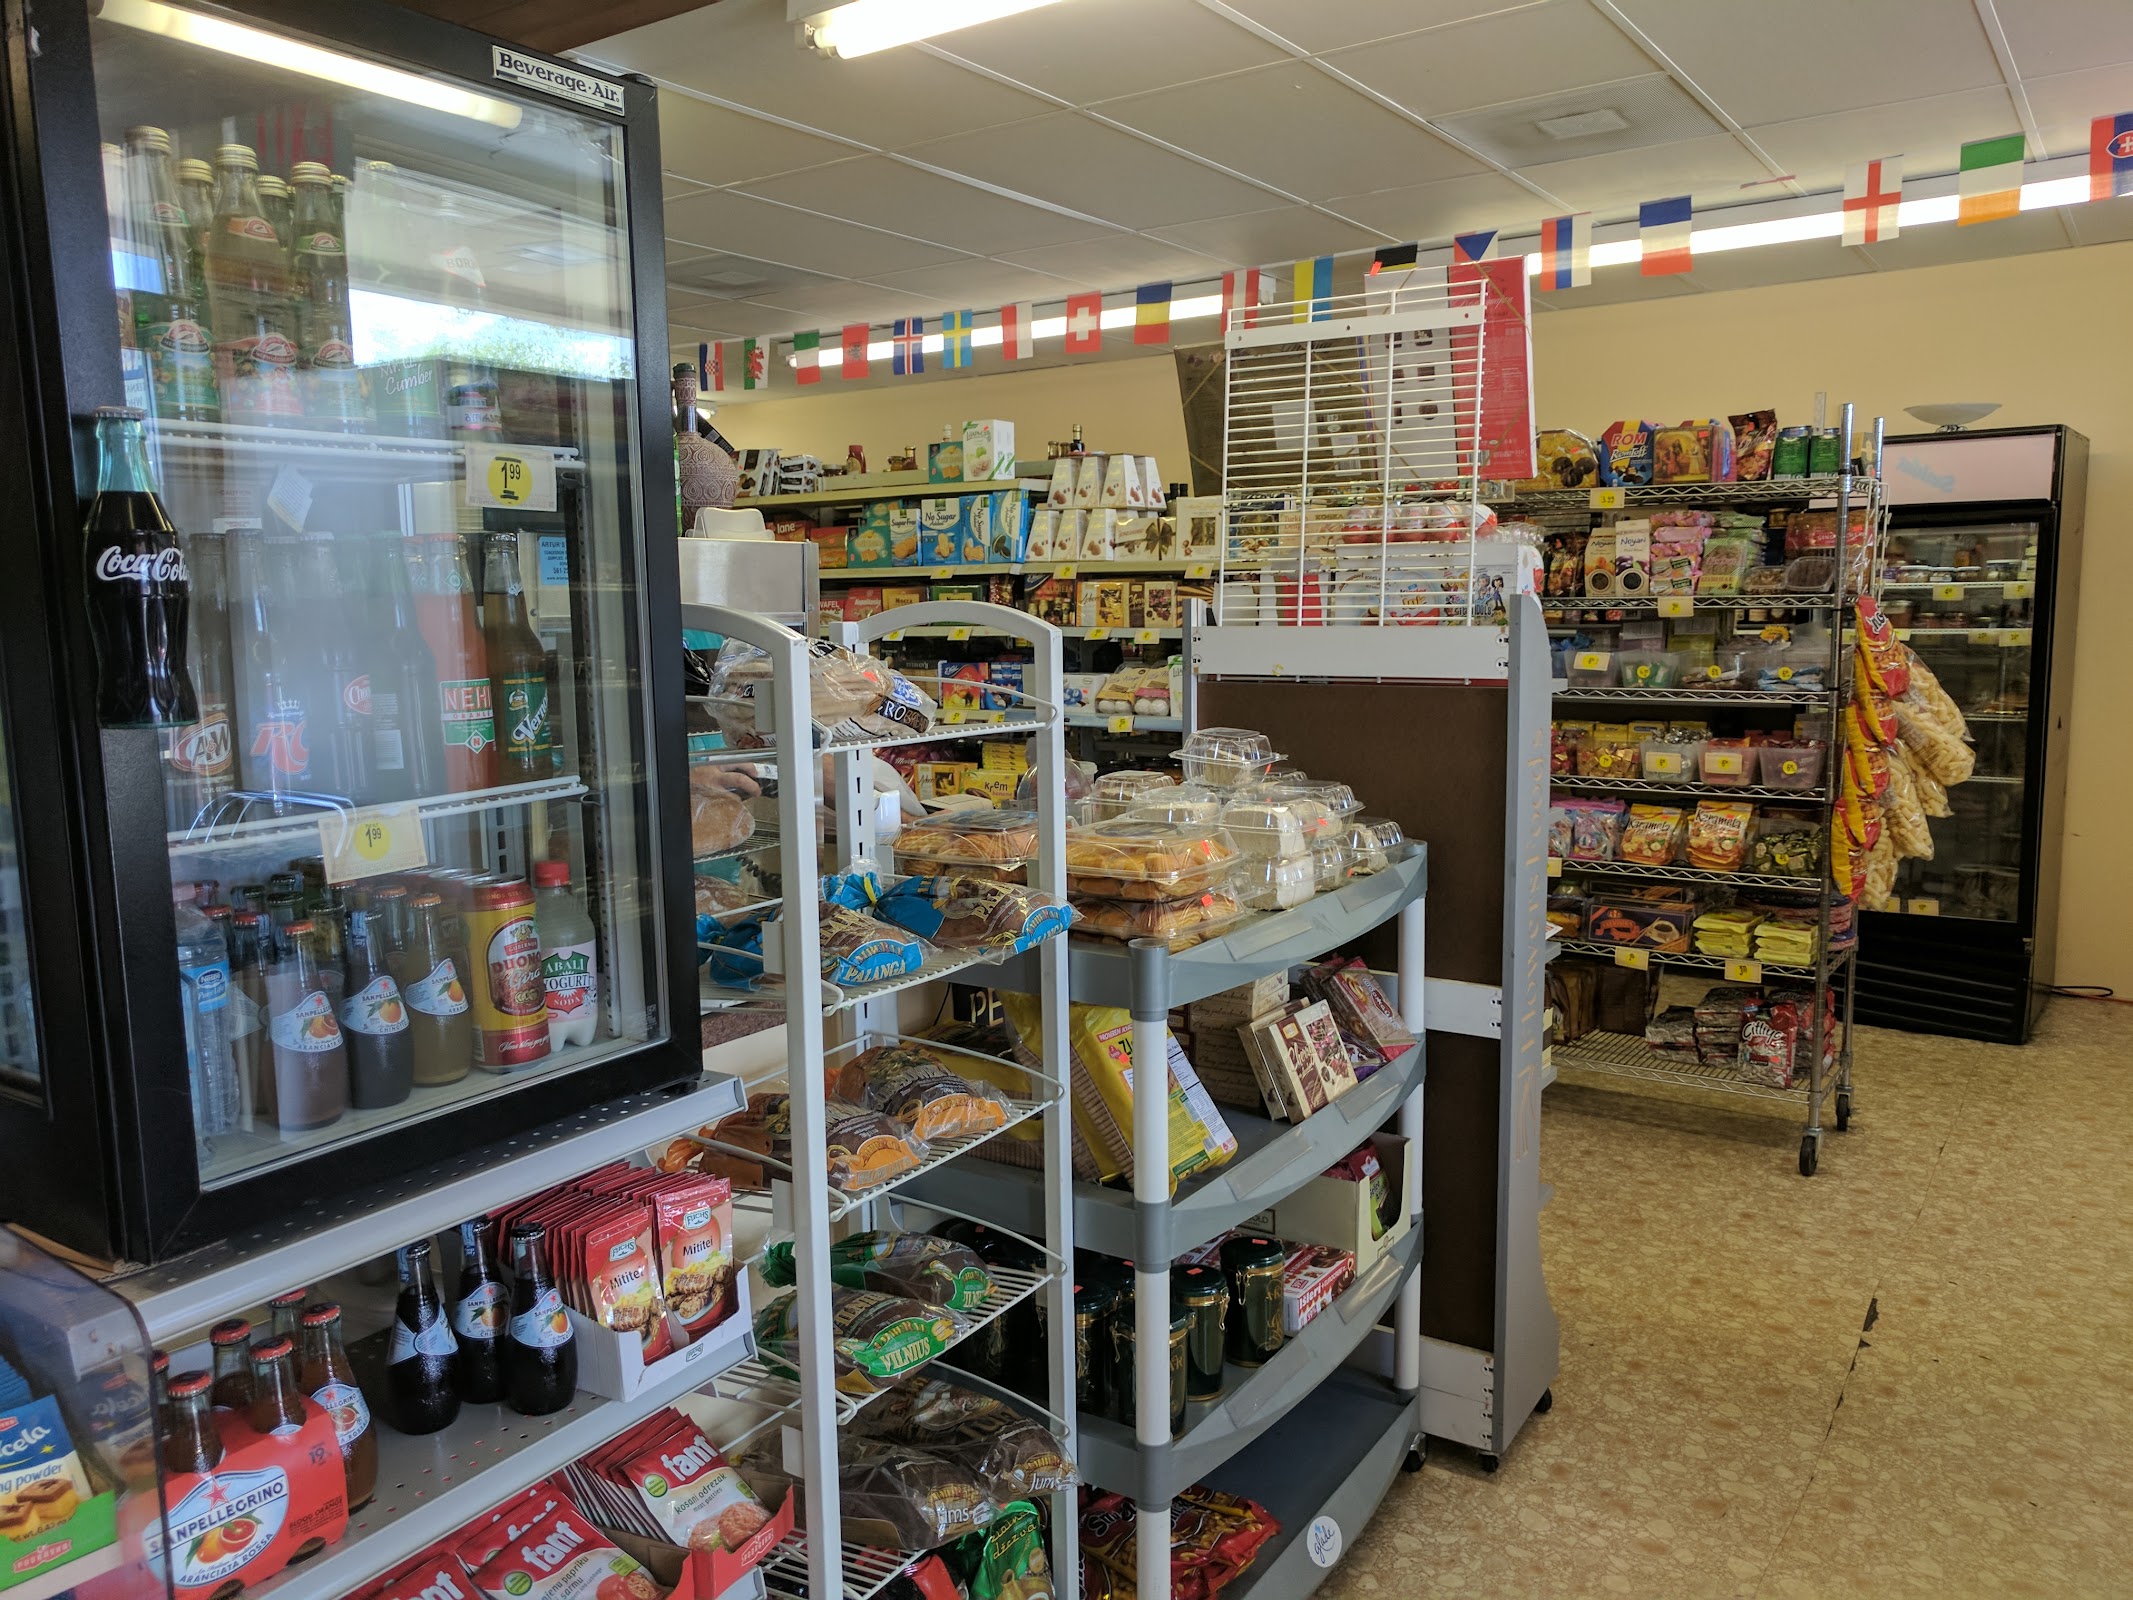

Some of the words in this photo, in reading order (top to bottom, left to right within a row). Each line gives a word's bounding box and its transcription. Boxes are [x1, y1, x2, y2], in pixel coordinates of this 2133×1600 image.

[385, 366, 433, 395] Cumber
[1611, 431, 1648, 447] ROM
[925, 512, 935, 521] No
[936, 512, 957, 524] Sugar
[191, 725, 231, 767] A&W
[544, 958, 585, 976] ABALI
[844, 958, 907, 982] PALANGA
[543, 973, 590, 992] YOGURT
[553, 995, 581, 1007] SODA
[686, 1209, 709, 1225] FUCHS
[612, 1239, 636, 1257] FUCHS
[682, 1235, 714, 1258] Mititei
[879, 1336, 931, 1373] VILNIUS
[15, 1462, 62, 1488] powder
[674, 1495, 699, 1516] kosani
[698, 1473, 728, 1501] odrezak
[705, 1486, 723, 1506] patties
[179, 1560, 240, 1585] ARANCIATA
[241, 1532, 274, 1563] ROSSA
[561, 1554, 590, 1591] papriku
